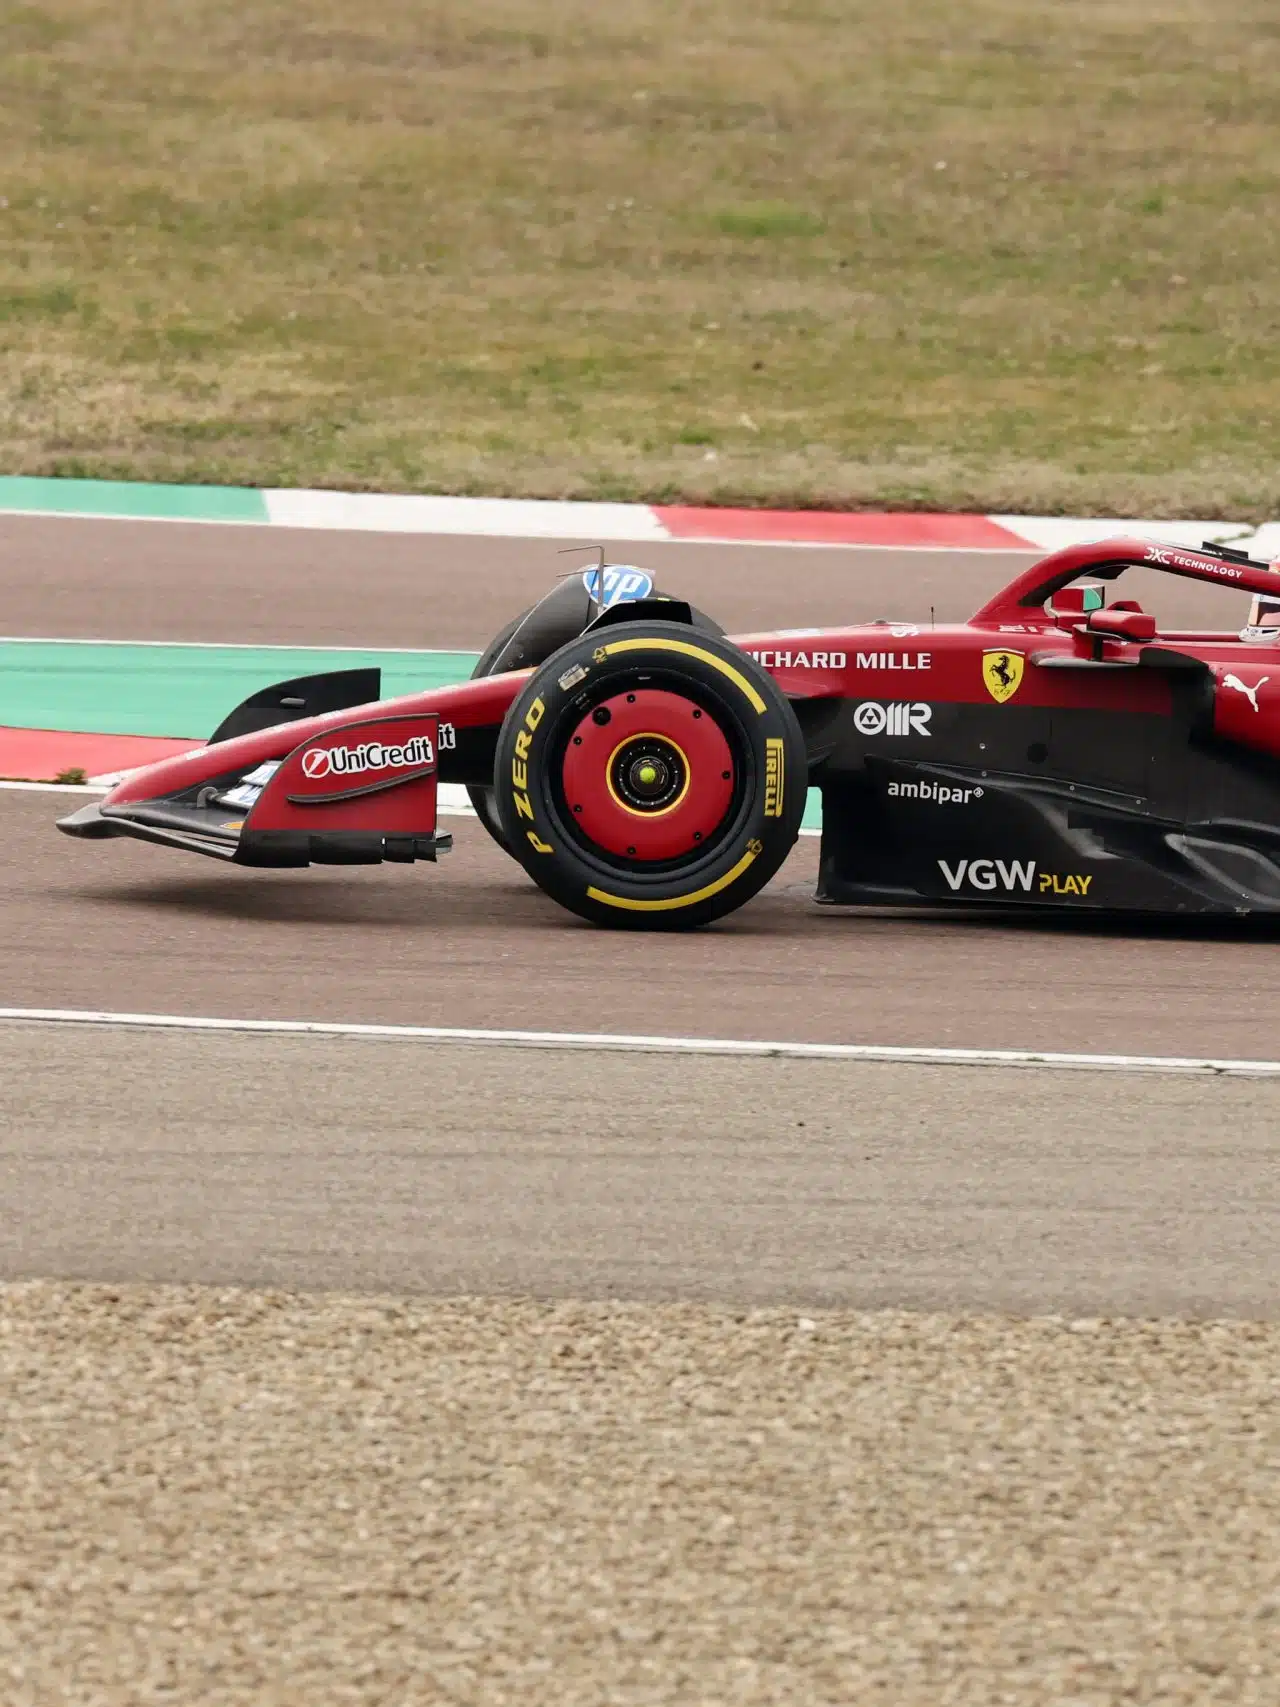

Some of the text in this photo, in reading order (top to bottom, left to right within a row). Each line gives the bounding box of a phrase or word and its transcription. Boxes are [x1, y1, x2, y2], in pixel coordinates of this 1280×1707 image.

[1174, 556, 1243, 579] TECHNOLOGY
[591, 567, 644, 606] hp
[746, 651, 932, 670] ICHARD MILLE
[331, 739, 431, 772] UniCredit
[512, 696, 546, 820] ZERO
[764, 738, 784, 817] PIRELLI
[887, 781, 972, 804] ambipar
[937, 860, 1093, 895] VGW PLAY
